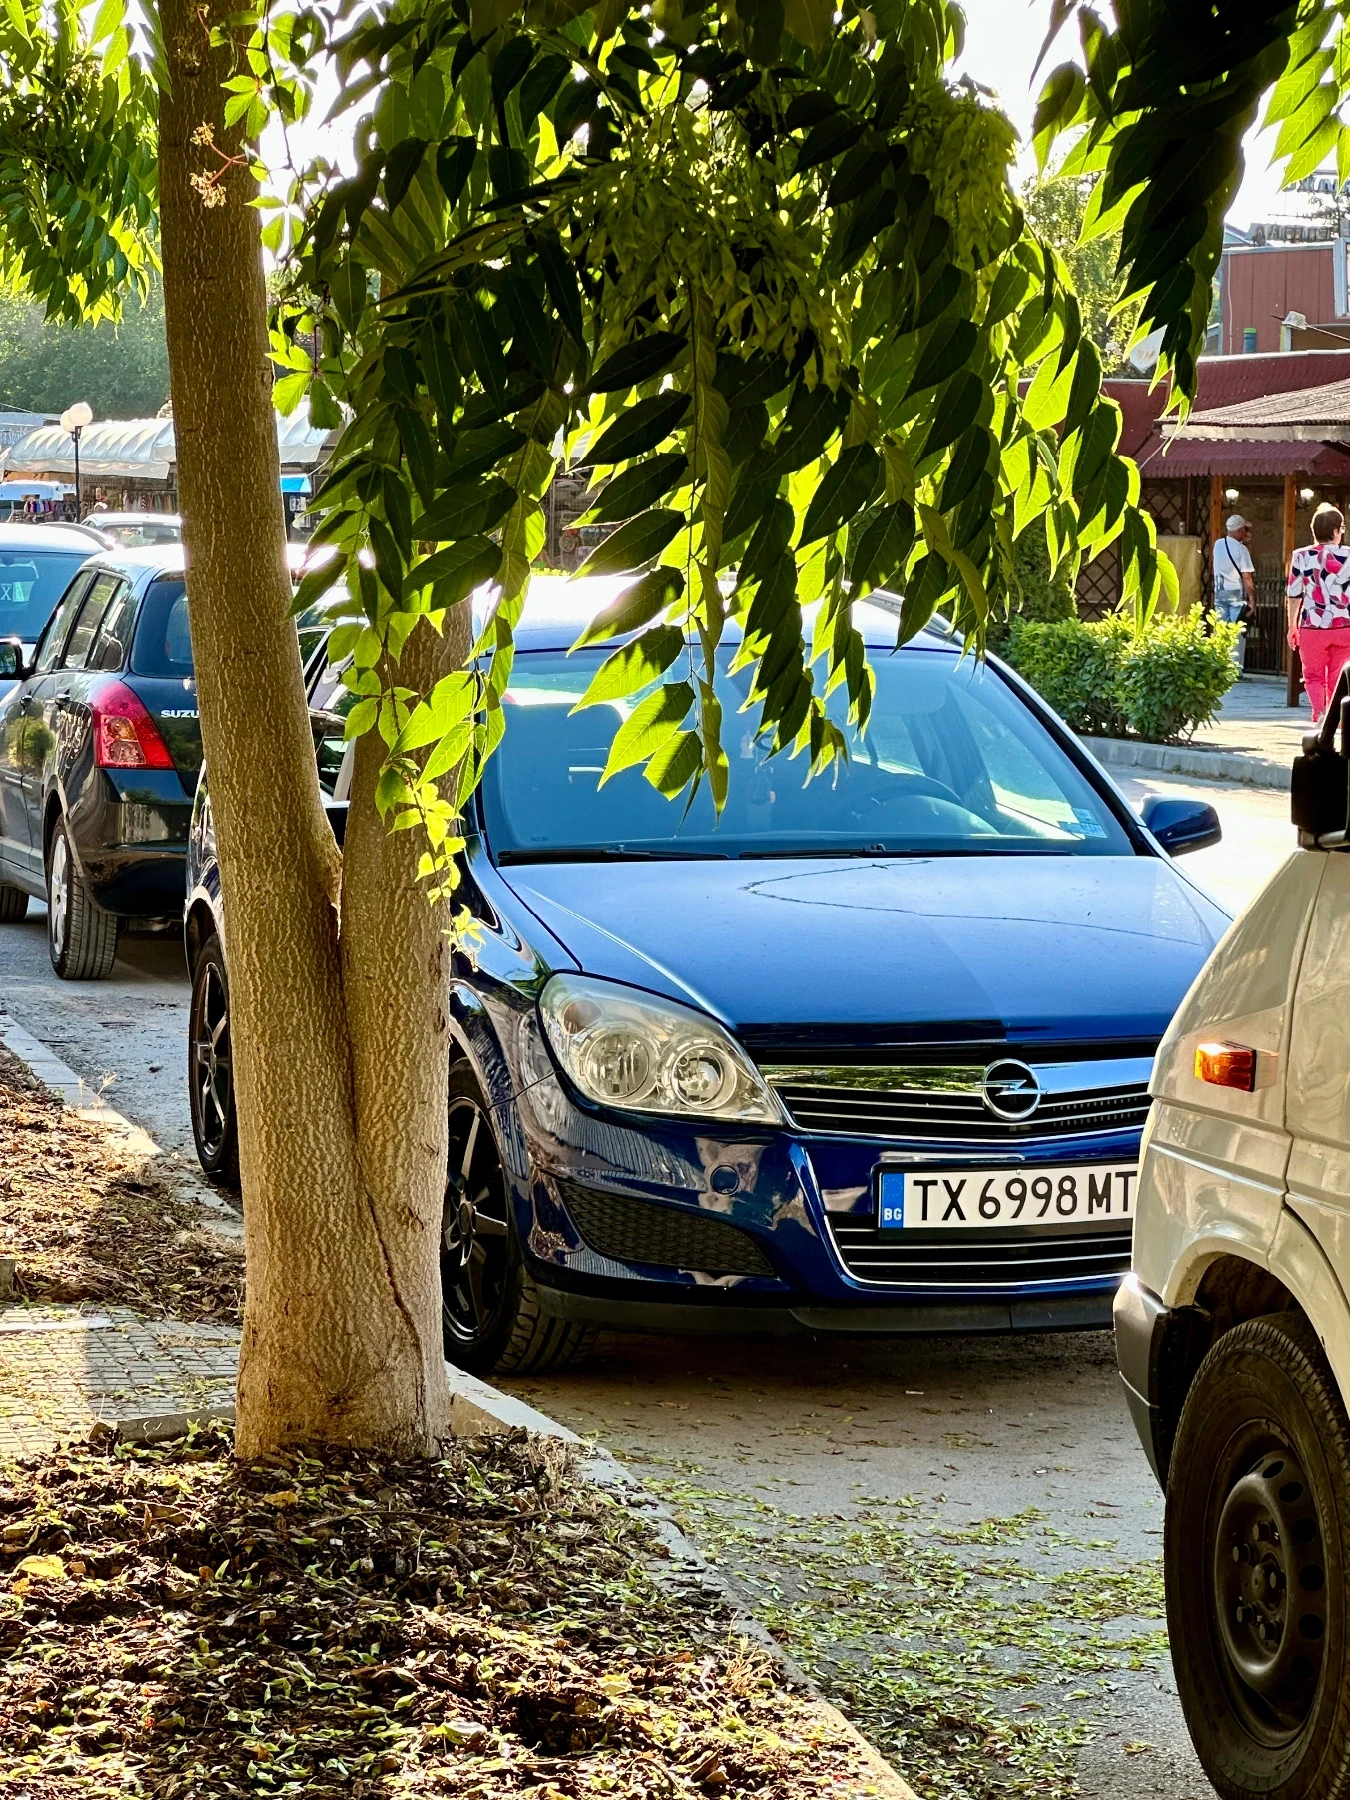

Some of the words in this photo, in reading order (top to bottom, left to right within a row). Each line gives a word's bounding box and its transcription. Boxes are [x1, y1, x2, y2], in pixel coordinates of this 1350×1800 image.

[160, 709, 200, 719] SUZU
[913, 1179, 967, 1221] TX
[978, 1174, 1078, 1220] 6998
[1088, 1170, 1138, 1214] MT
[883, 1207, 902, 1221] BG
